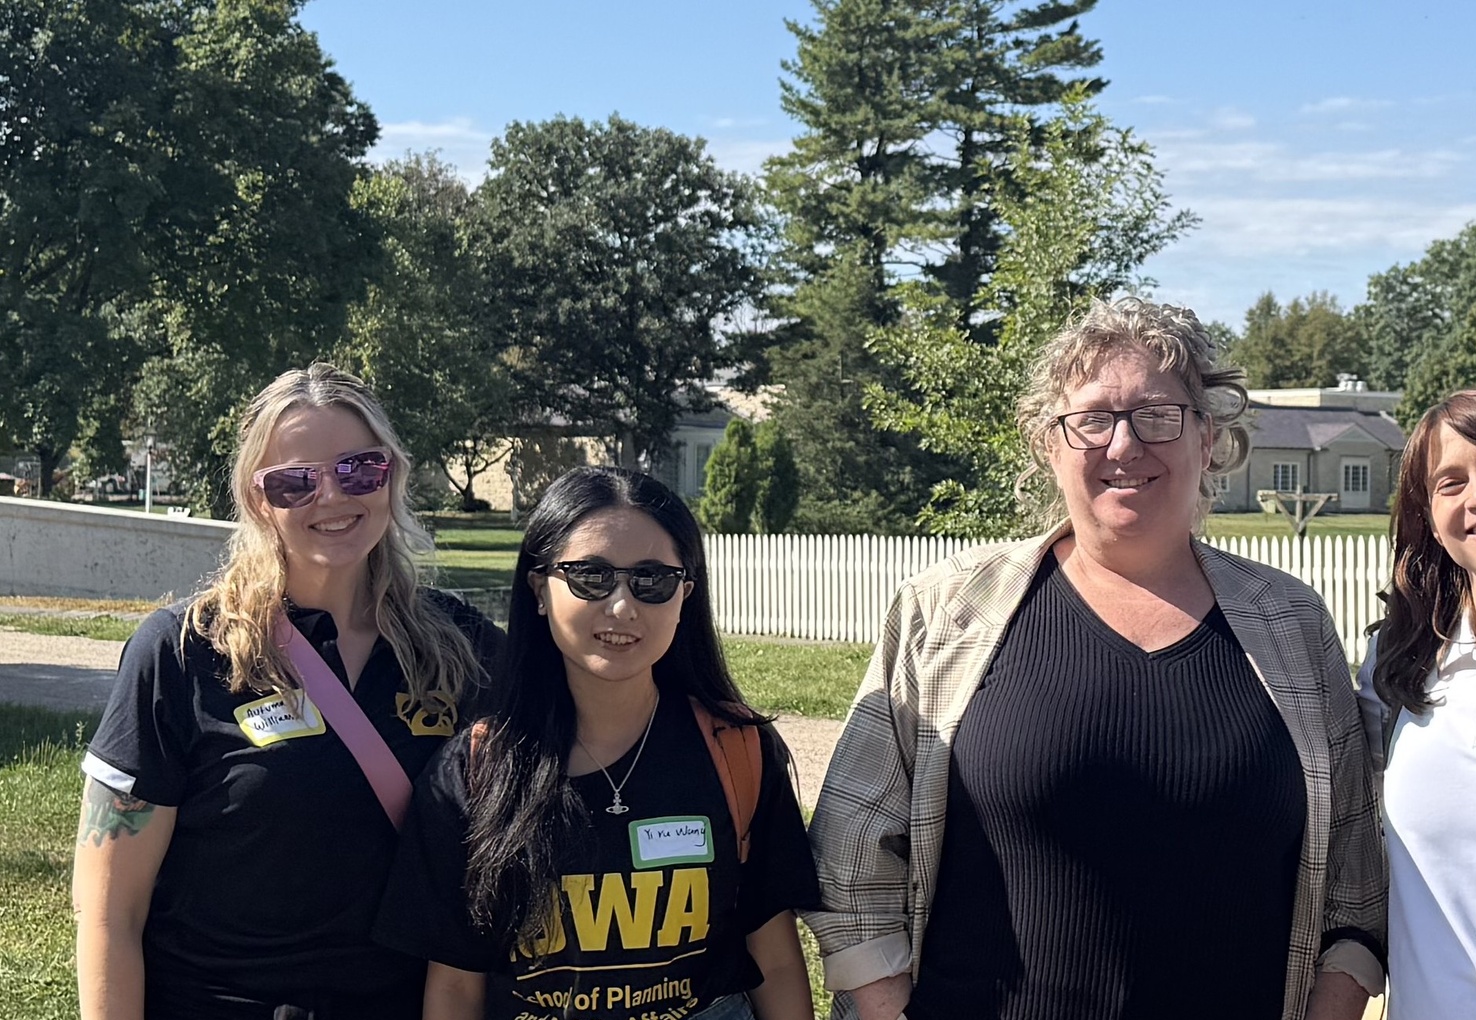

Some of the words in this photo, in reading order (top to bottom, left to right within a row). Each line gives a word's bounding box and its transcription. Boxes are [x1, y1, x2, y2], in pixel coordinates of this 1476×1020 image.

[644, 829, 653, 840] Yi
[675, 824, 706, 847] Wang
[574, 987, 600, 1010] of
[607, 977, 692, 1009] Planning
